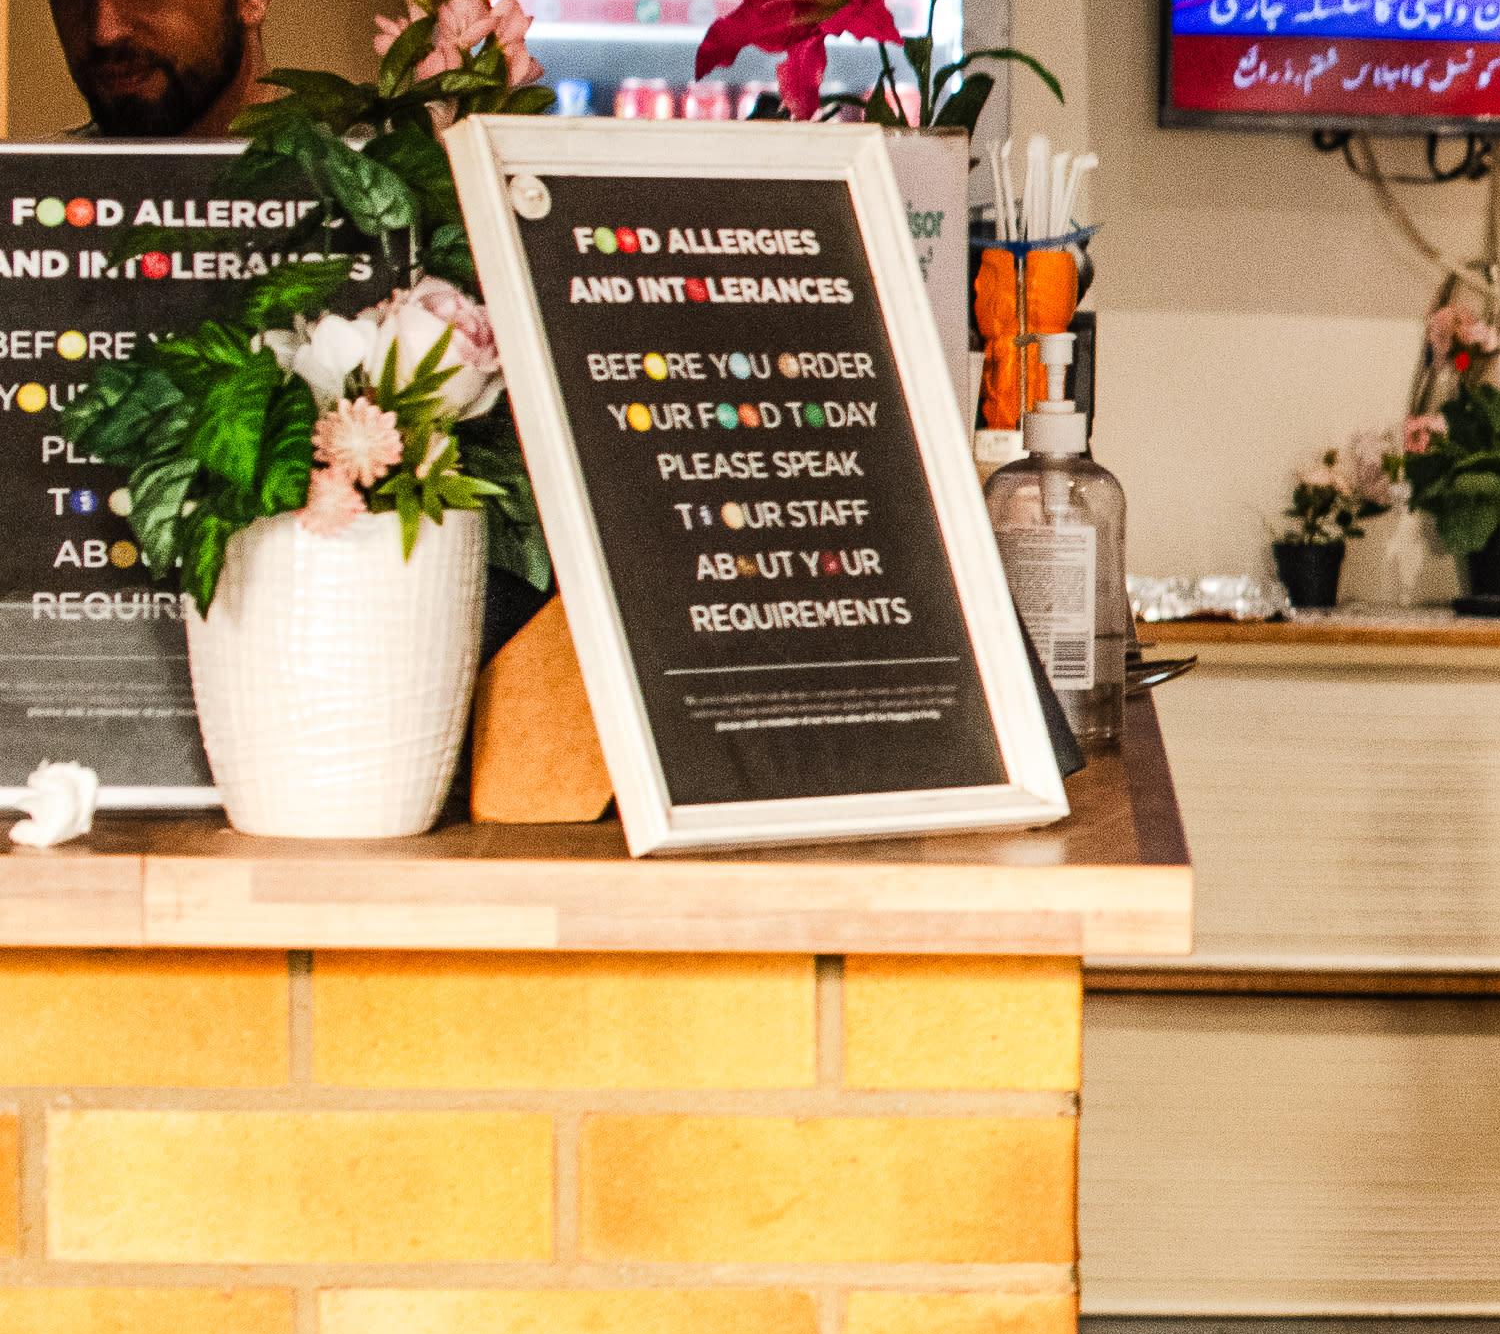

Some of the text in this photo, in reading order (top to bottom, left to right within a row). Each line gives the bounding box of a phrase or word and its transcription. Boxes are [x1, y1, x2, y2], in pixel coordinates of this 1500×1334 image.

[11, 197, 344, 228] FOOD ALLERGI
[573, 227, 820, 255] FOOD ALLERGIES
[570, 277, 854, 304] AND INTOLERANCES
[587, 352, 877, 381] BEFORE YOU ORDER
[607, 402, 878, 432] YOUR FOOD TODAY
[657, 450, 864, 481] PLEASE SPEAK
[721, 501, 783, 530] OUR
[787, 499, 869, 528] STAFF
[697, 548, 883, 581] ABOUT YOUR
[689, 597, 912, 633] REQUIREMENTS
